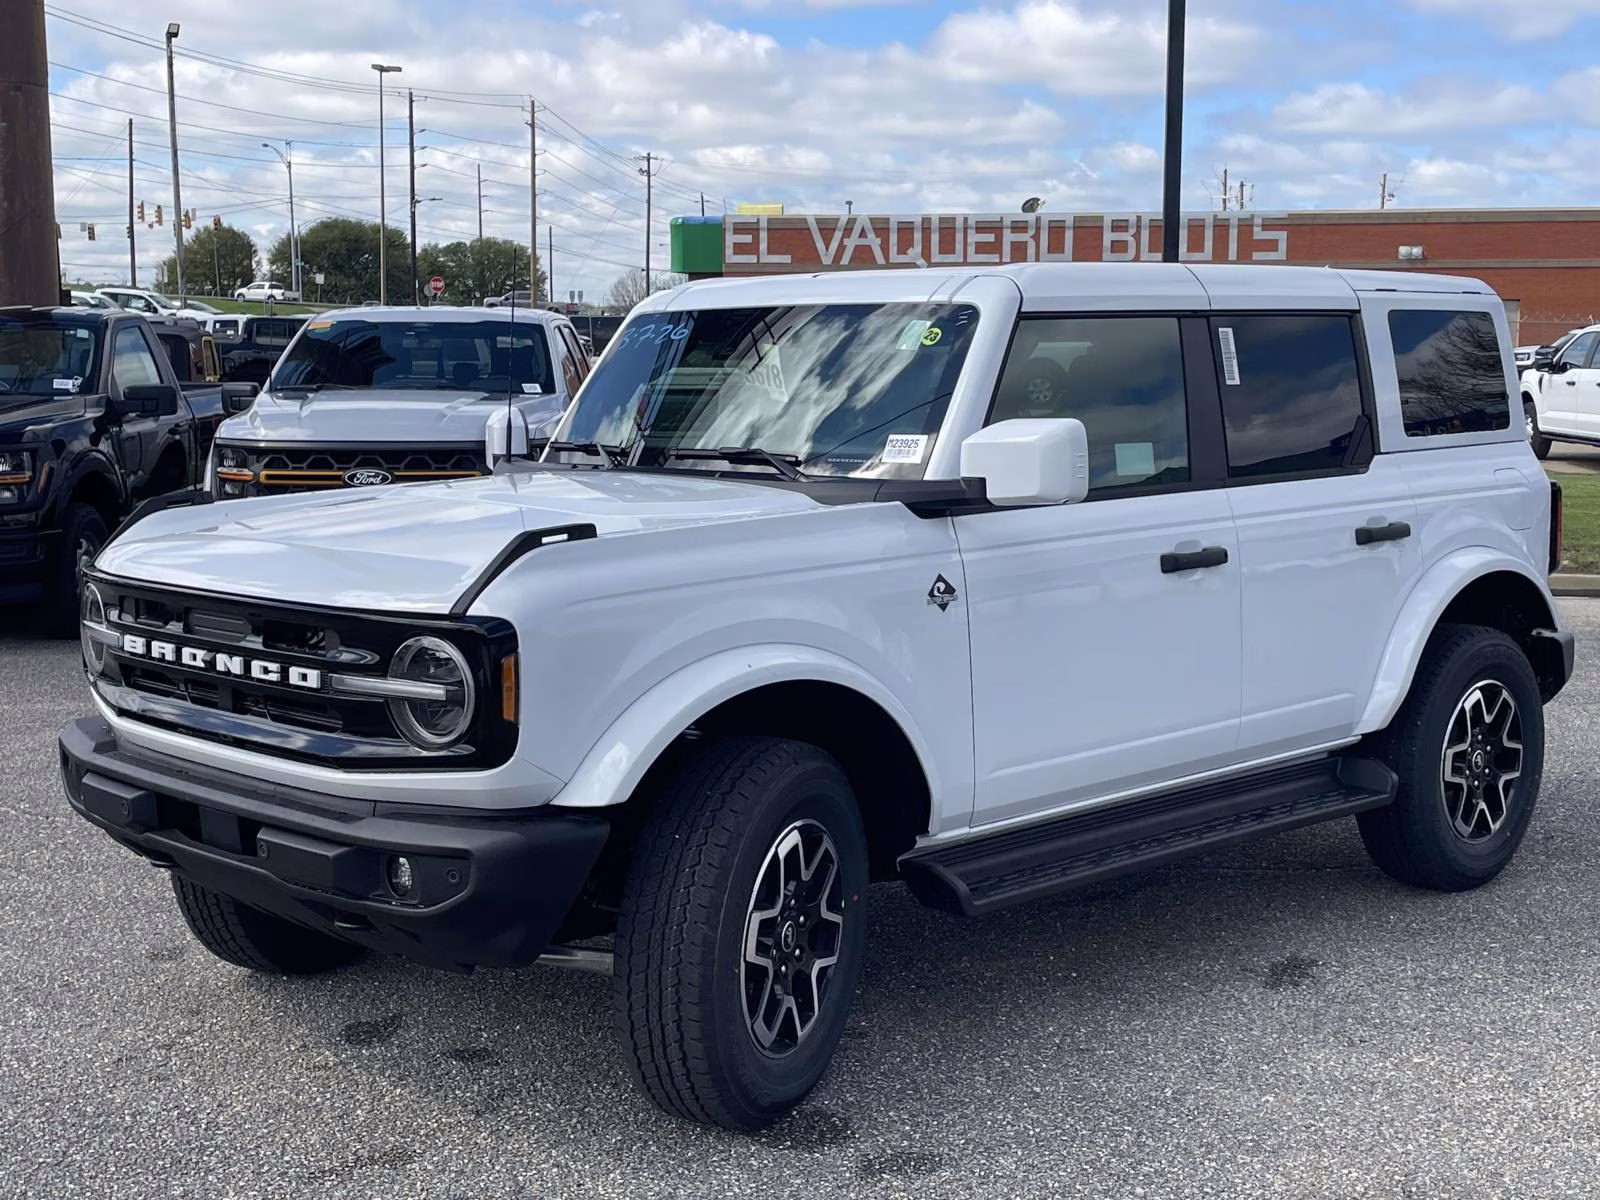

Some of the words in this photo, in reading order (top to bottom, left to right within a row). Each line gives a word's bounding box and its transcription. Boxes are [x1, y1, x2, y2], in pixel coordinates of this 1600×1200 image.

[725, 214, 792, 264] EL
[806, 213, 1074, 267] VAQUERO
[1103, 211, 1289, 262] BOOTS
[923, 329, 940, 342] 23
[887, 438, 920, 449] M23925
[353, 471, 384, 484] Ford
[123, 633, 322, 689] BRONCO
